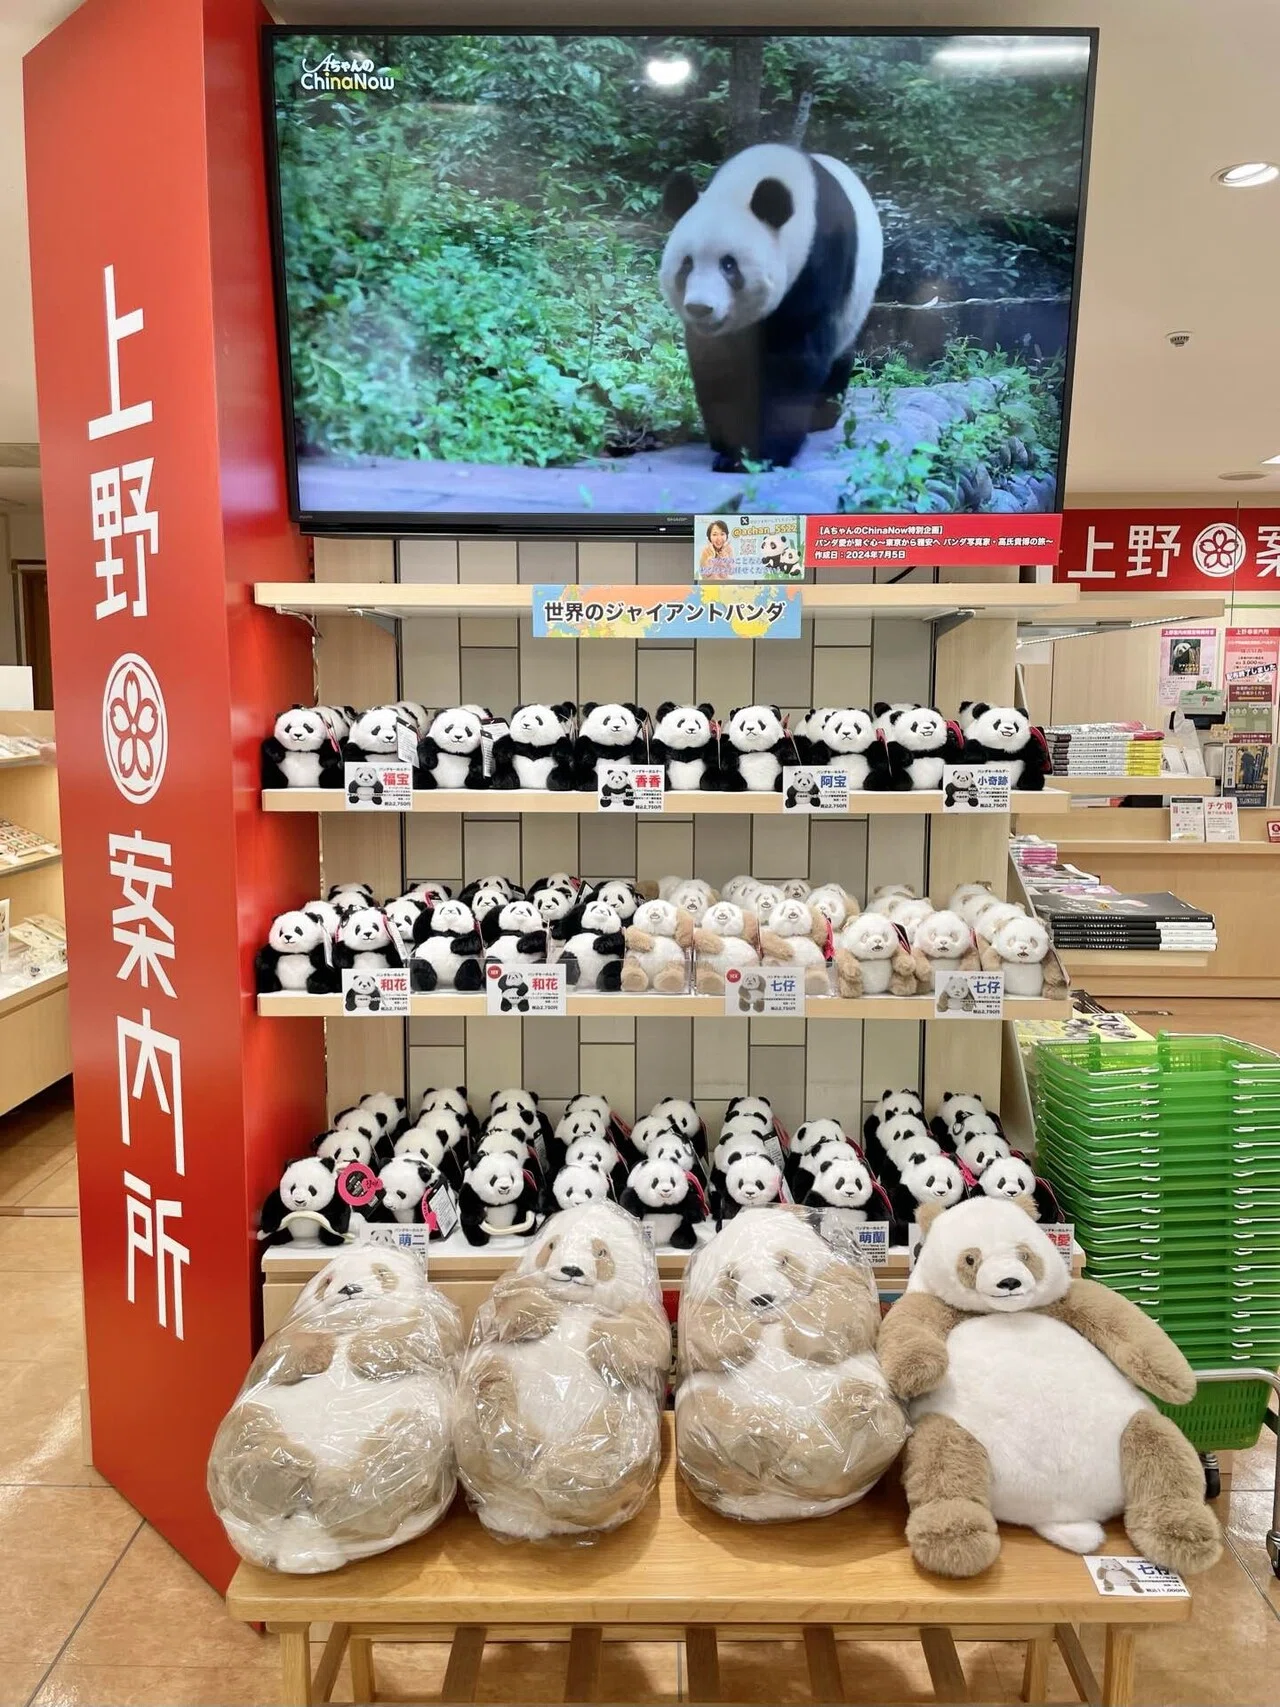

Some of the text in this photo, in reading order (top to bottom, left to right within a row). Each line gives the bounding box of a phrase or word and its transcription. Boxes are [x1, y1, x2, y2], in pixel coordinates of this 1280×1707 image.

[302, 53, 375, 73] Aちゃんの
[300, 72, 395, 90] ChinaNow
[1067, 525, 1181, 579] 上野
[544, 601, 786, 623] 世界のジャイアントパンダ
[383, 772, 409, 786] 福宝
[635, 775, 661, 788] 香香
[820, 775, 847, 788] 阿宝
[977, 775, 1009, 786] 小奇跡
[88, 263, 191, 1342] 上野 案内所
[380, 978, 407, 991] 和花
[532, 977, 558, 991] 和花
[770, 980, 796, 992] 七仔
[973, 981, 1001, 994] 七仔
